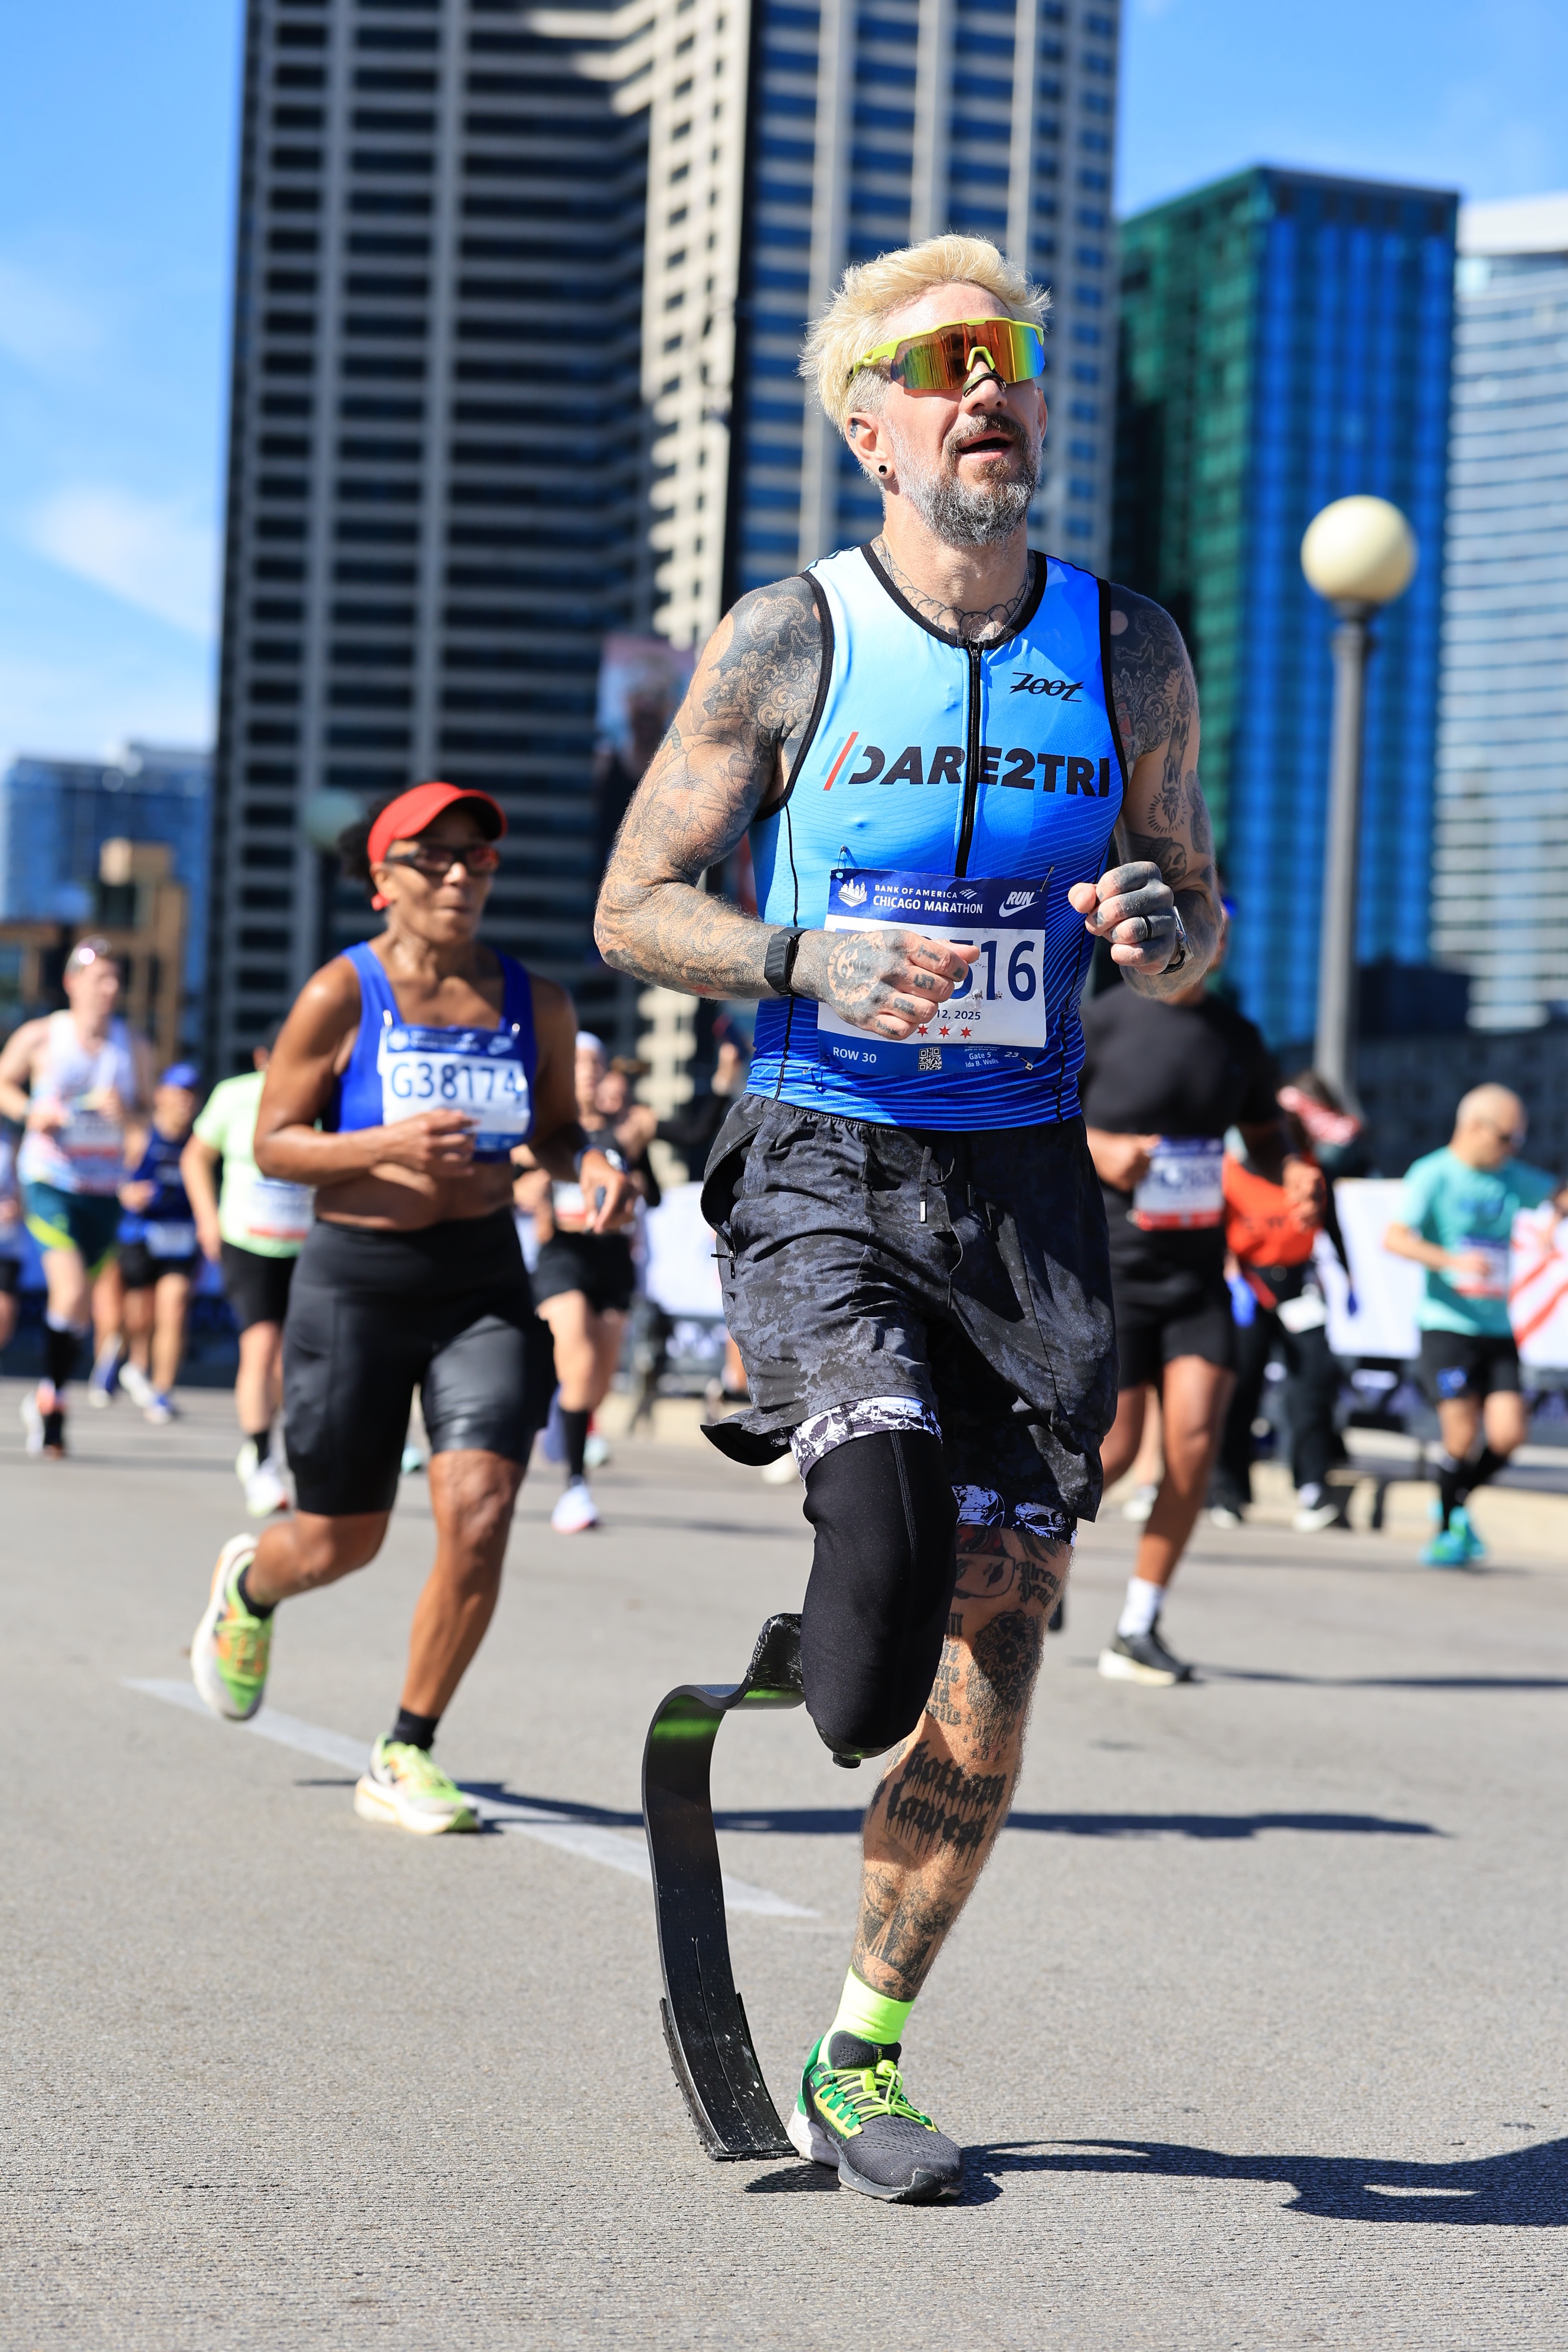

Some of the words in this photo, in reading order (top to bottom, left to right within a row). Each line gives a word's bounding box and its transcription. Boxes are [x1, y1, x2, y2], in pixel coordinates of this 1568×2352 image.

[874, 884, 899, 894] BANK
[916, 889, 958, 899] AMERICA
[1005, 891, 1035, 906] RUN
[873, 895, 921, 910] CHICAGO
[924, 900, 983, 914] MARATHON
[936, 1010, 951, 1020] 12,
[954, 1010, 981, 1020] 2025
[833, 1047, 860, 1060] ROW
[861, 1053, 877, 1063] 30
[391, 1062, 525, 1102] G38174
